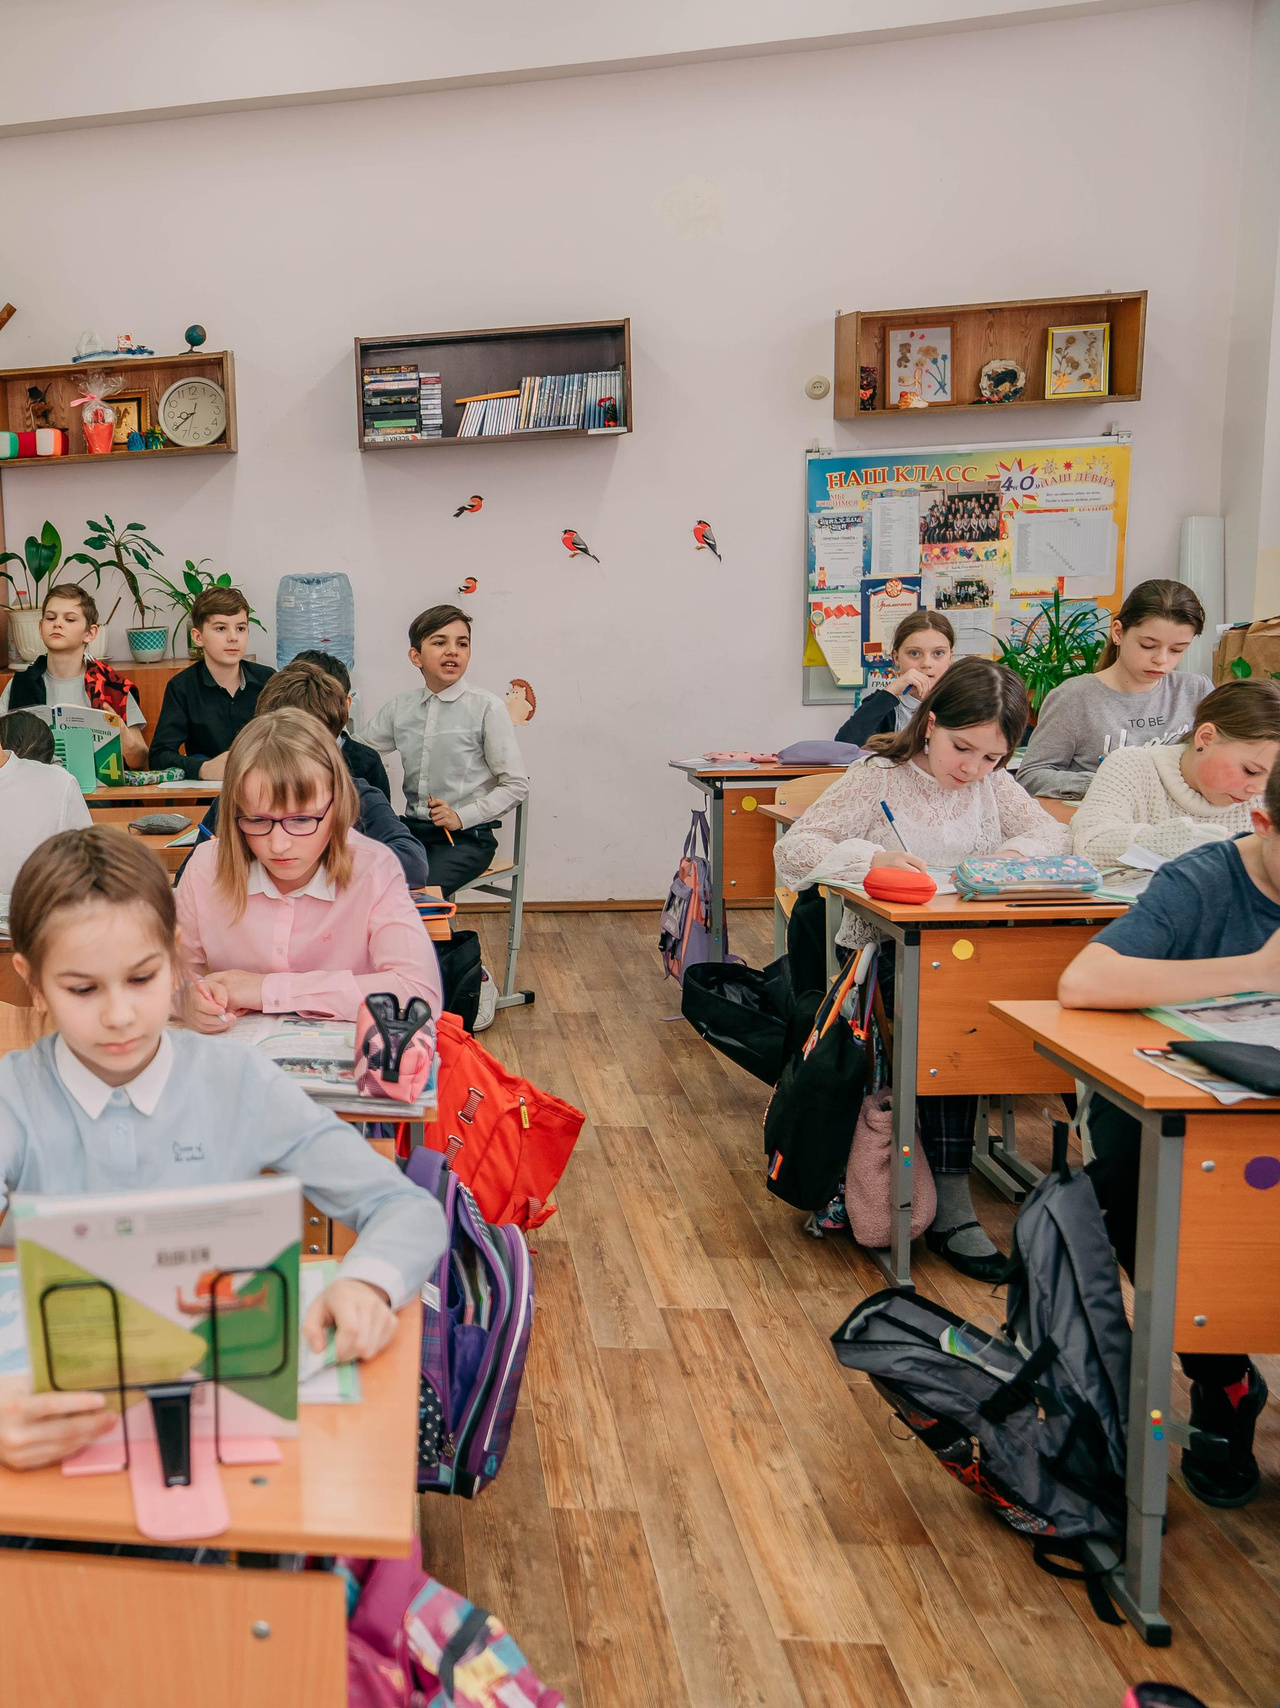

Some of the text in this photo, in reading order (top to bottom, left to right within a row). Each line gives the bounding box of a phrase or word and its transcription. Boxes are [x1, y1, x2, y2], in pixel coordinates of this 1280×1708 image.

[177, 390, 184, 398] 11
[188, 386, 197, 395] 12
[210, 394, 217, 403] 2
[214, 406, 221, 415] 3
[211, 418, 218, 426] 4
[182, 430, 188, 438] 7
[193, 431, 200, 440] 6
[204, 427, 211, 436] 5
[826, 464, 978, 490] НАШ КЛАСС
[1074, 472, 1116, 487] ДЕВИЗ
[1128, 716, 1166, 728] TO BE
[99, 753, 121, 779] 4
